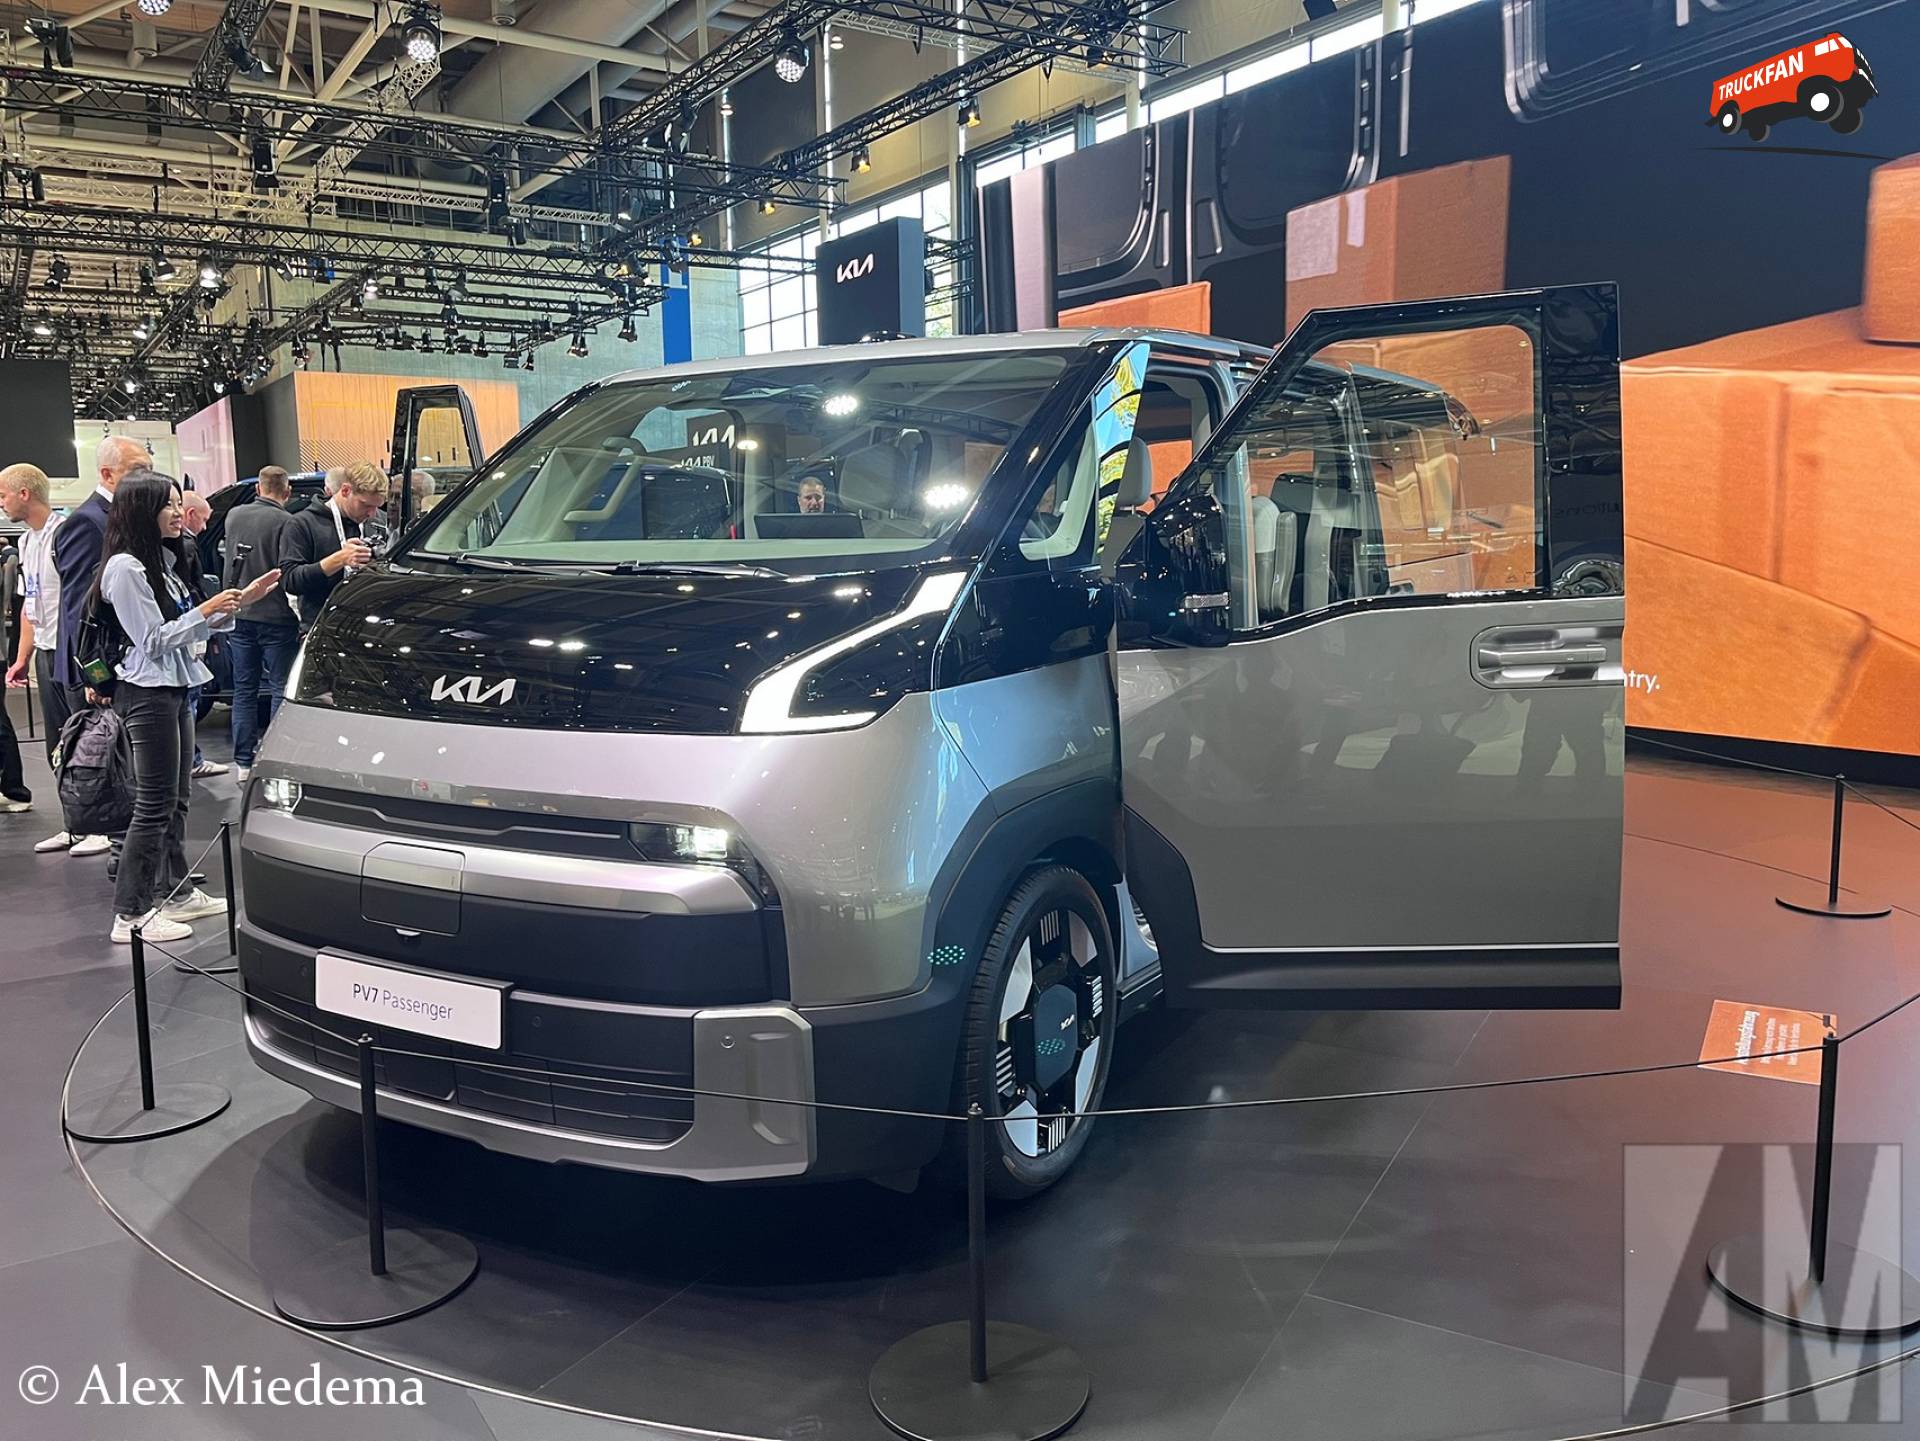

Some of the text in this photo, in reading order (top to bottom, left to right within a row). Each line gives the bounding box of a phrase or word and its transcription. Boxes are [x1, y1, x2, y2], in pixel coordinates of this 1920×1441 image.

[836, 253, 874, 283] KIA
[430, 674, 517, 706] KIA
[353, 982, 453, 1021] PV7 Passenger
